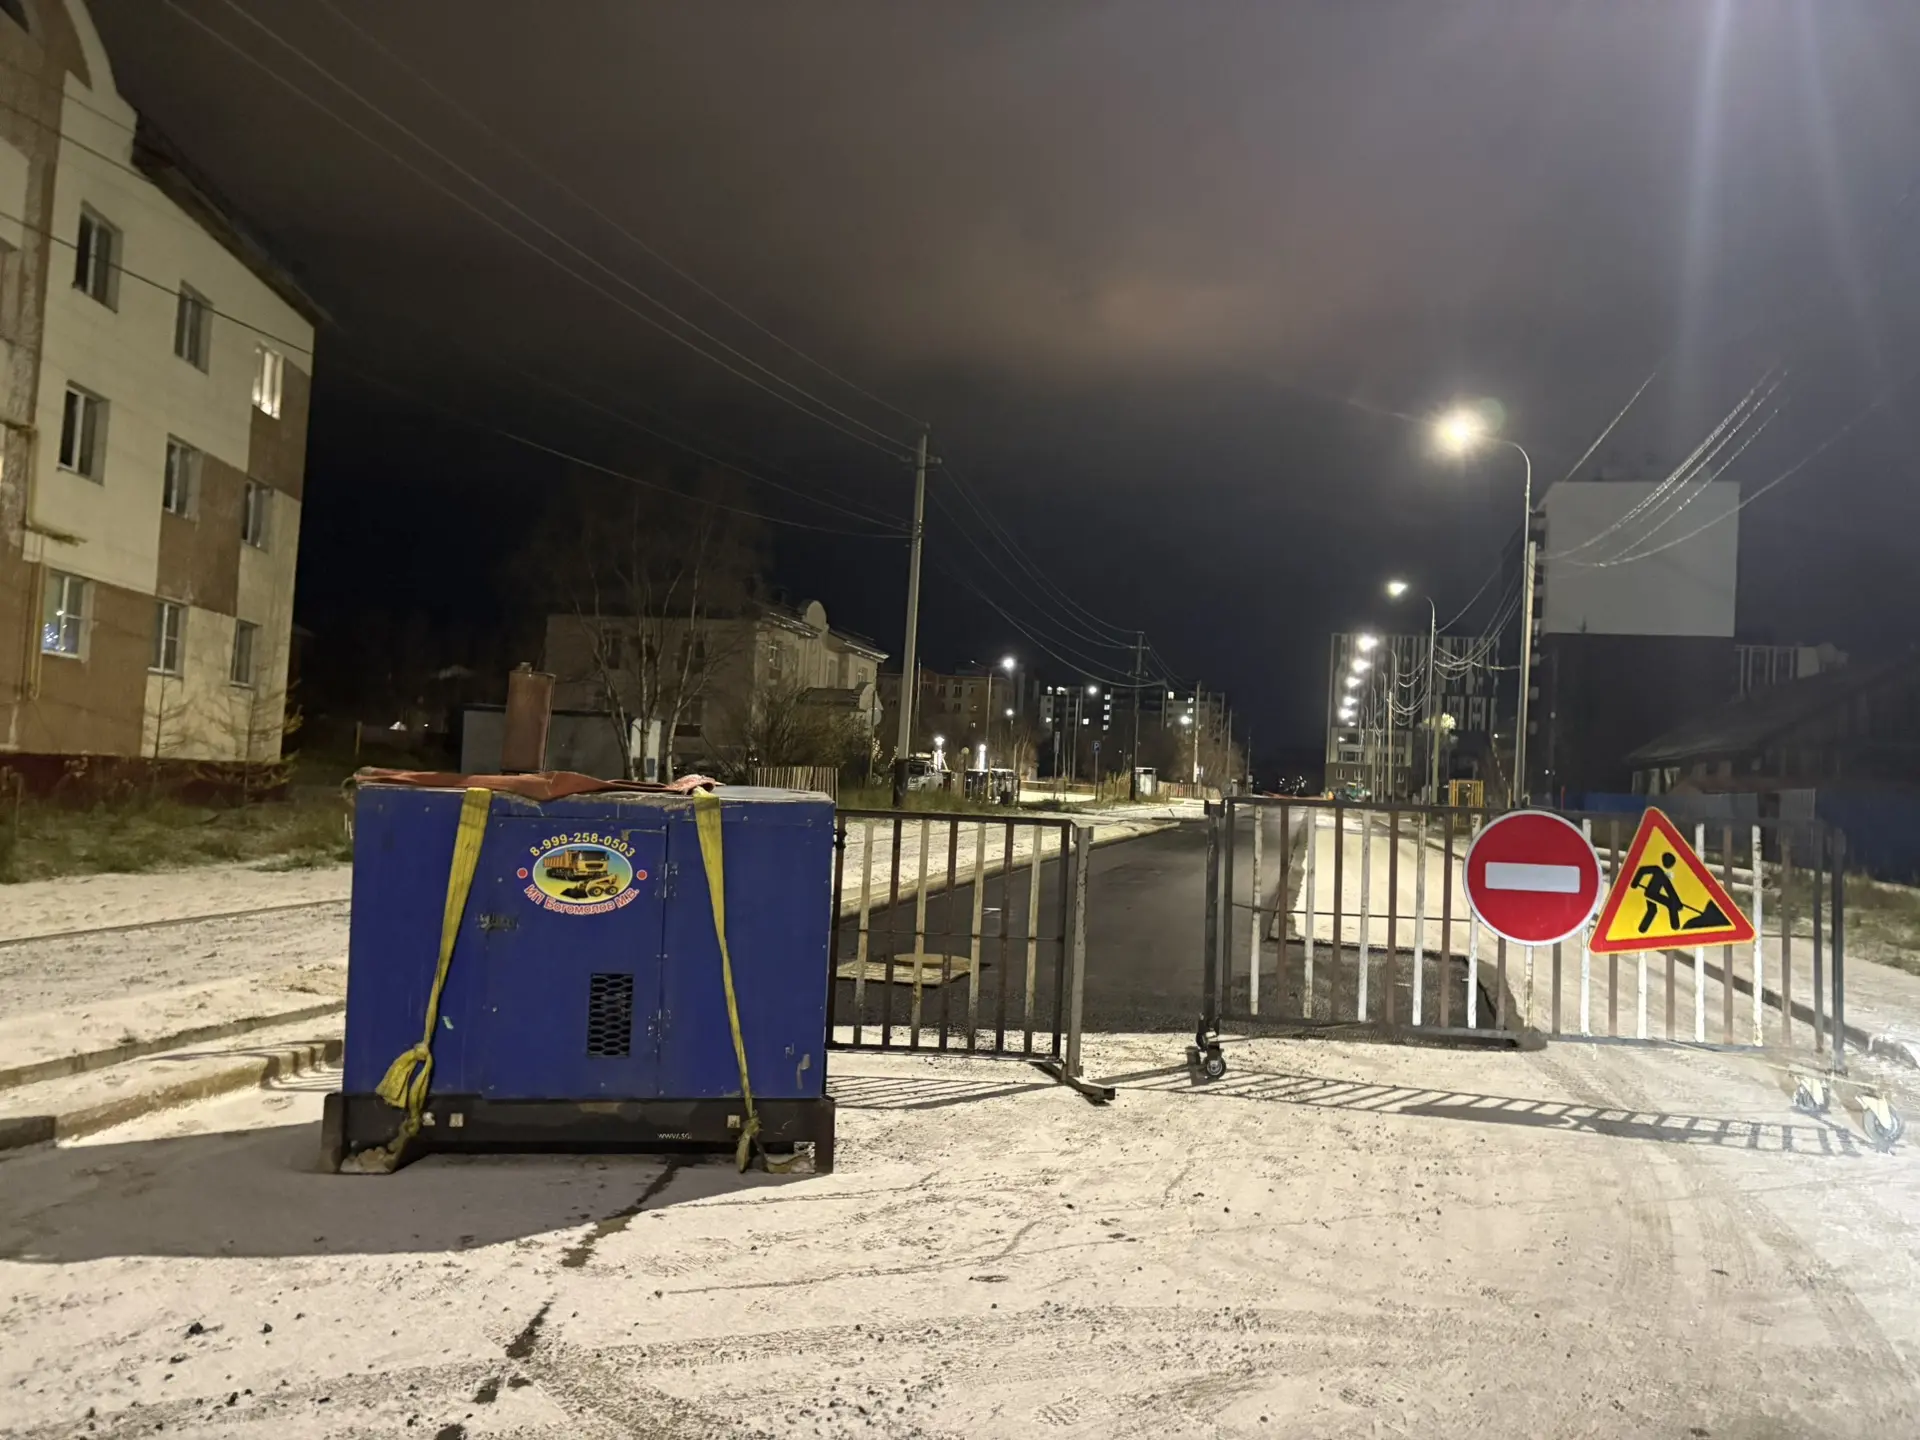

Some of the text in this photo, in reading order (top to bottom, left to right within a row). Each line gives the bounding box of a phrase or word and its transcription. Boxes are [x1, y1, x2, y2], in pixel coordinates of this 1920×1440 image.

[529, 832, 636, 858] 8-999-258-0503
[524, 884, 545, 905] ИП
[543, 896, 616, 915] Богомолов
